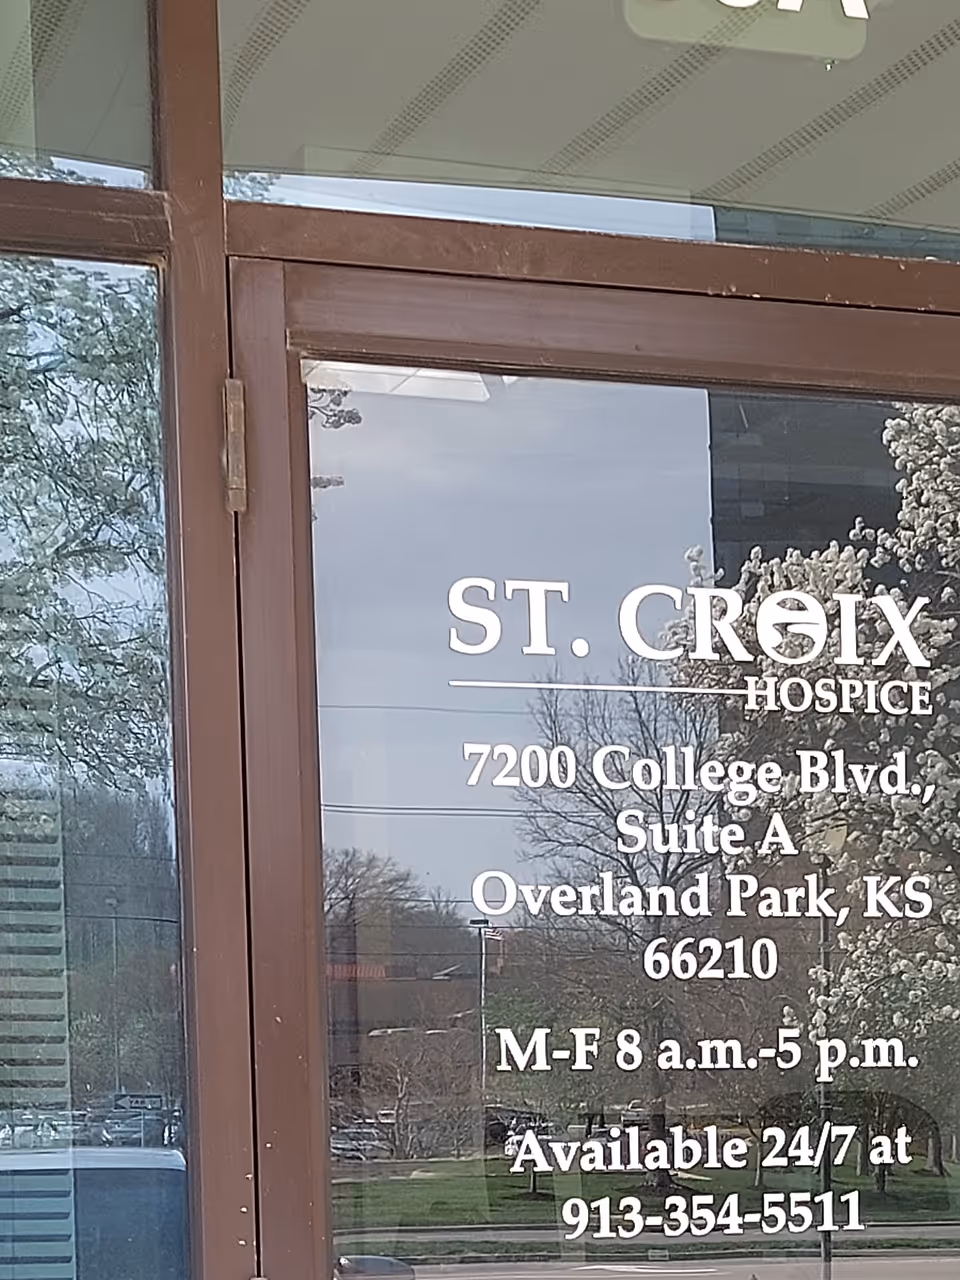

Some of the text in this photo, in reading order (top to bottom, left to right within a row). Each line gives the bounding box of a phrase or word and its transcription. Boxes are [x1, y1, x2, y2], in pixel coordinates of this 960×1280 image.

[448, 577, 932, 668] ST. CROIX
[744, 676, 933, 716] HOSPICE
[463, 743, 936, 807] 7200 College Blvd.,
[616, 809, 799, 855] Suite A
[472, 870, 933, 926] Overland Park, KS
[644, 937, 778, 980] 66210
[495, 1028, 919, 1082] M-F 8 a.m.-5 p.m.
[508, 1121, 912, 1173] Available 24/7 at
[562, 1190, 866, 1240] 913-354-5511
